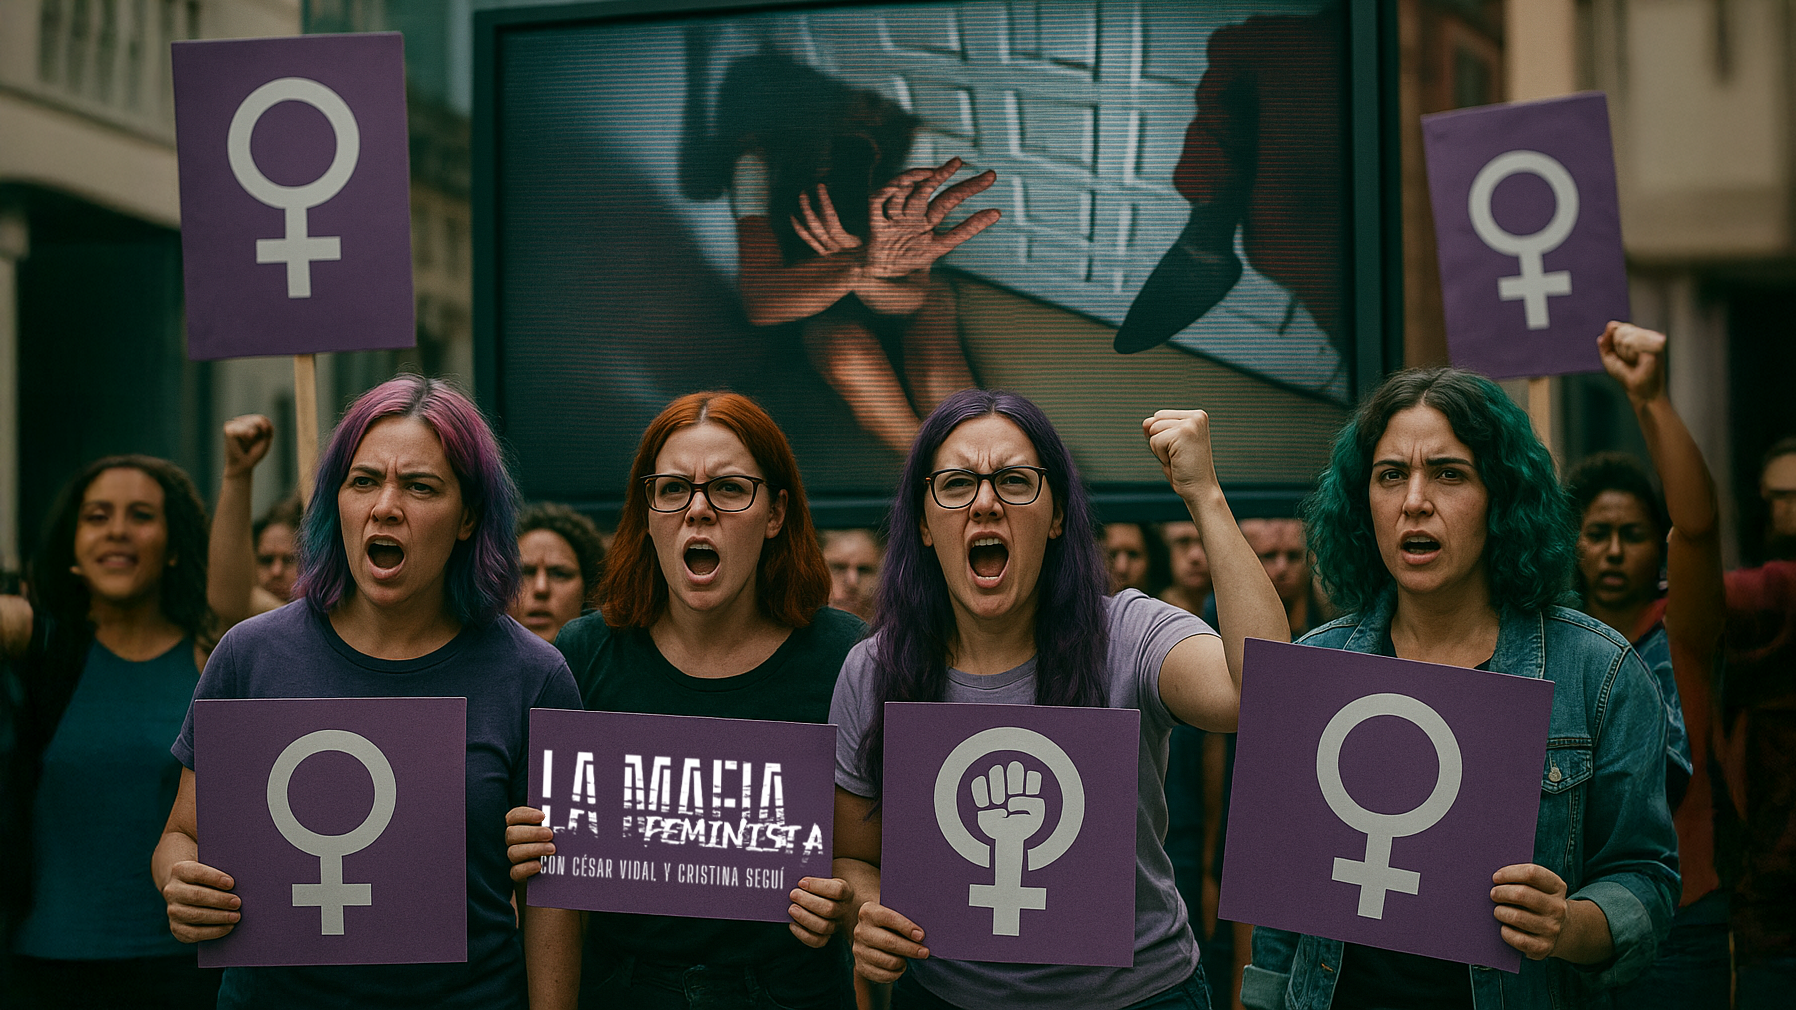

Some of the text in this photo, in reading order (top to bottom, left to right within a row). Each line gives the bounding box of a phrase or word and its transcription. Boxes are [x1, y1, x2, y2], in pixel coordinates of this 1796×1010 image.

[542, 749, 786, 838] LA MAFIA
[644, 815, 823, 863] FEMINISTA
[540, 854, 785, 890] CON CÉSAR VIDAL Y CRISTINA SEGUÍ
